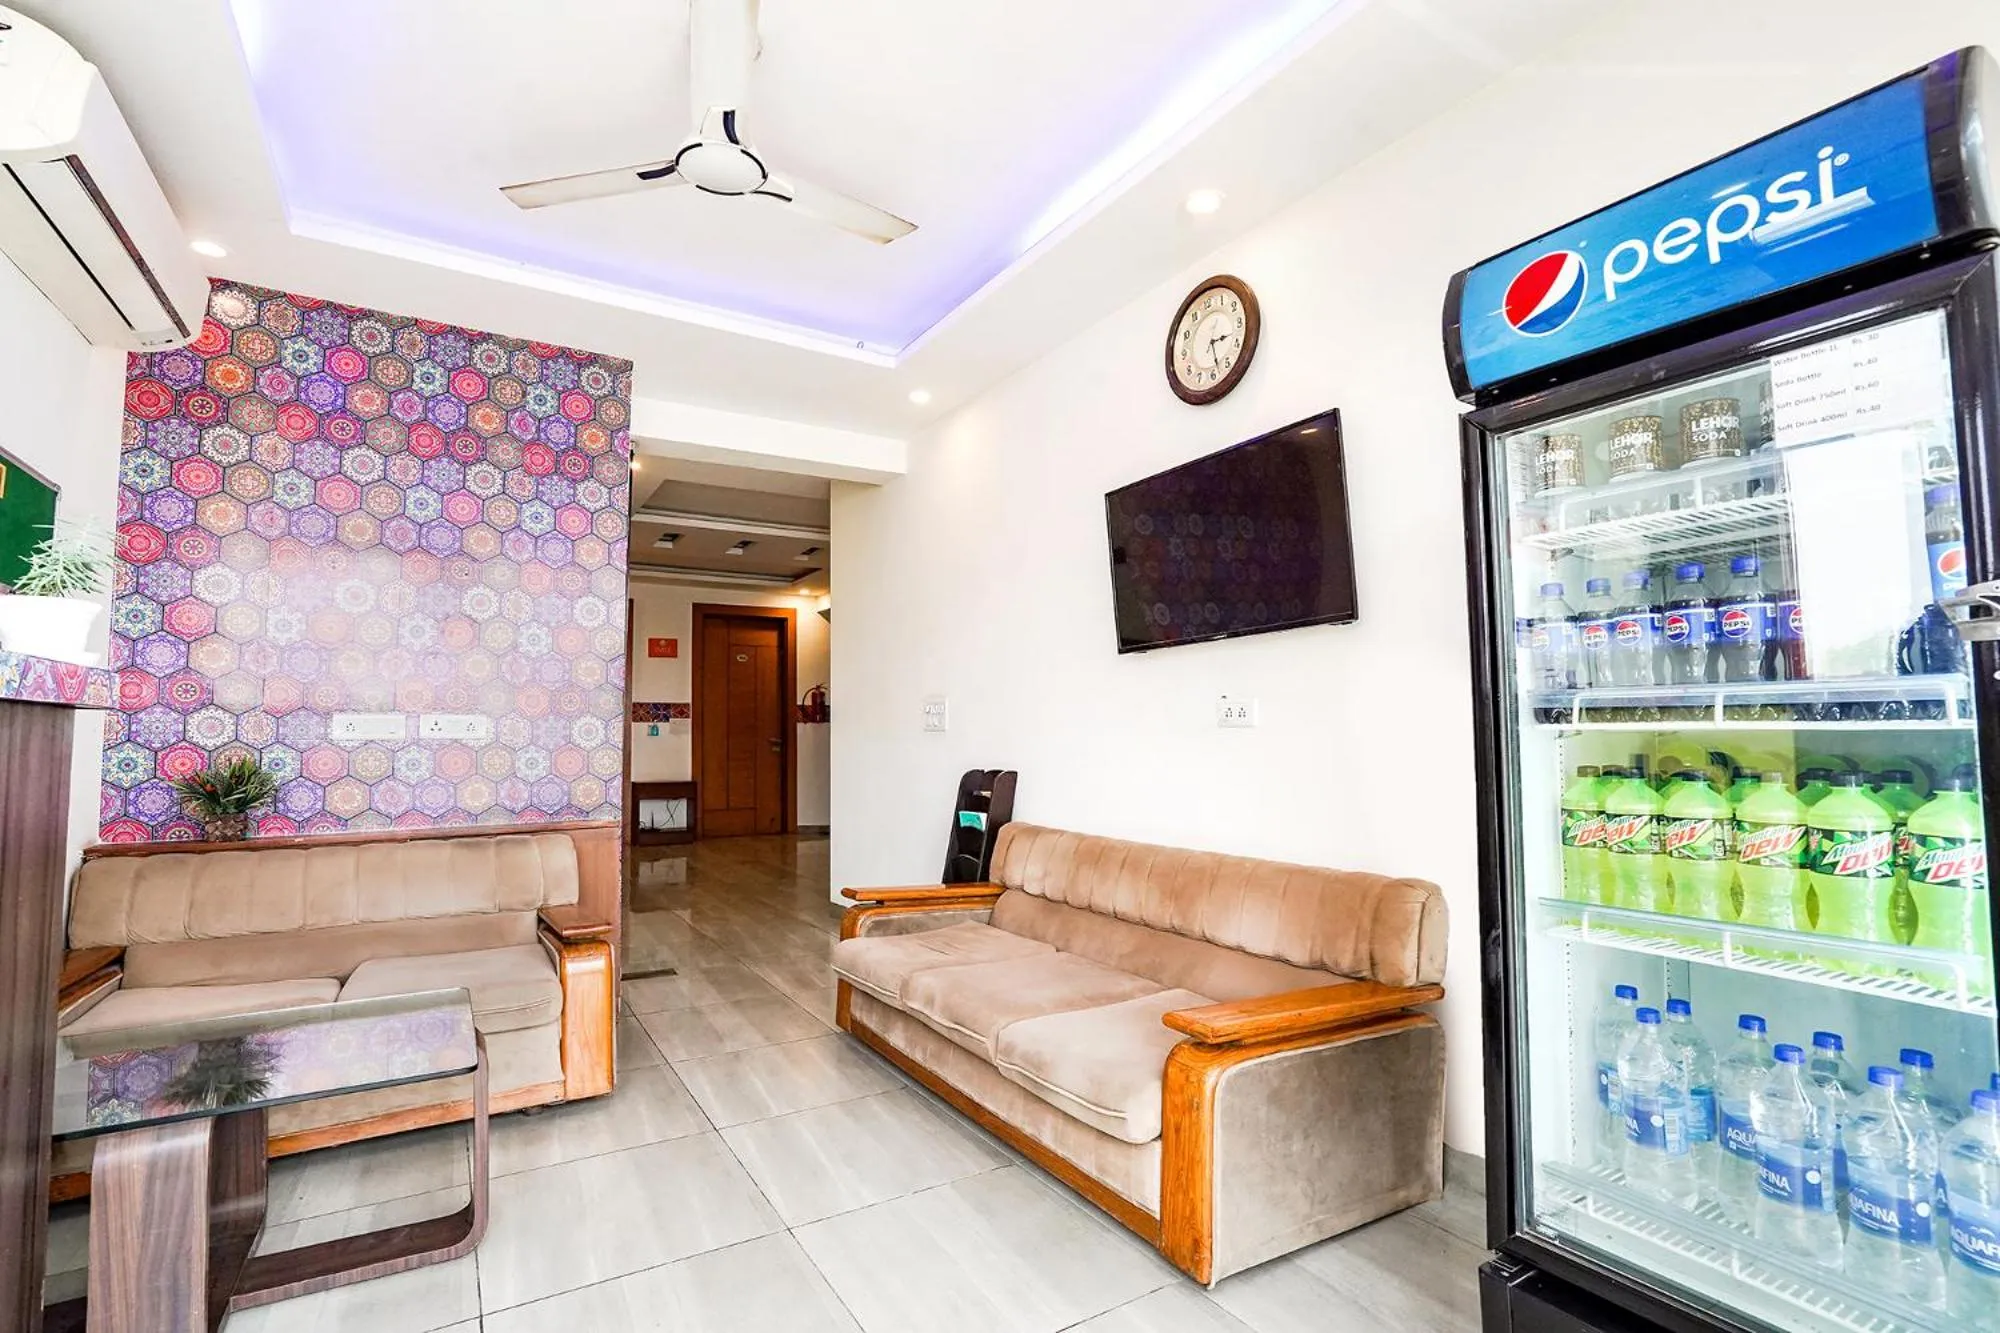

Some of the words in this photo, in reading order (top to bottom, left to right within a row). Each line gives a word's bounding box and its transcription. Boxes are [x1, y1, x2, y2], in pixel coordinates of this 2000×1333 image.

[1603, 146, 1836, 302] pepsi
[1203, 297, 1213, 310] 12
[1231, 300, 1238, 313] 2
[1191, 311, 1199, 322] 11
[1236, 316, 1243, 328] 3
[1183, 330, 1190, 341] 10
[1233, 338, 1240, 349] 4
[1181, 348, 1188, 360] 9
[1800, 347, 1826, 359] Bottle
[1224, 357, 1231, 369] 5
[1186, 364, 1192, 376] 8
[1209, 369, 1216, 381] 6
[1196, 372, 1202, 384] 7
[1692, 431, 1728, 444] SODA
